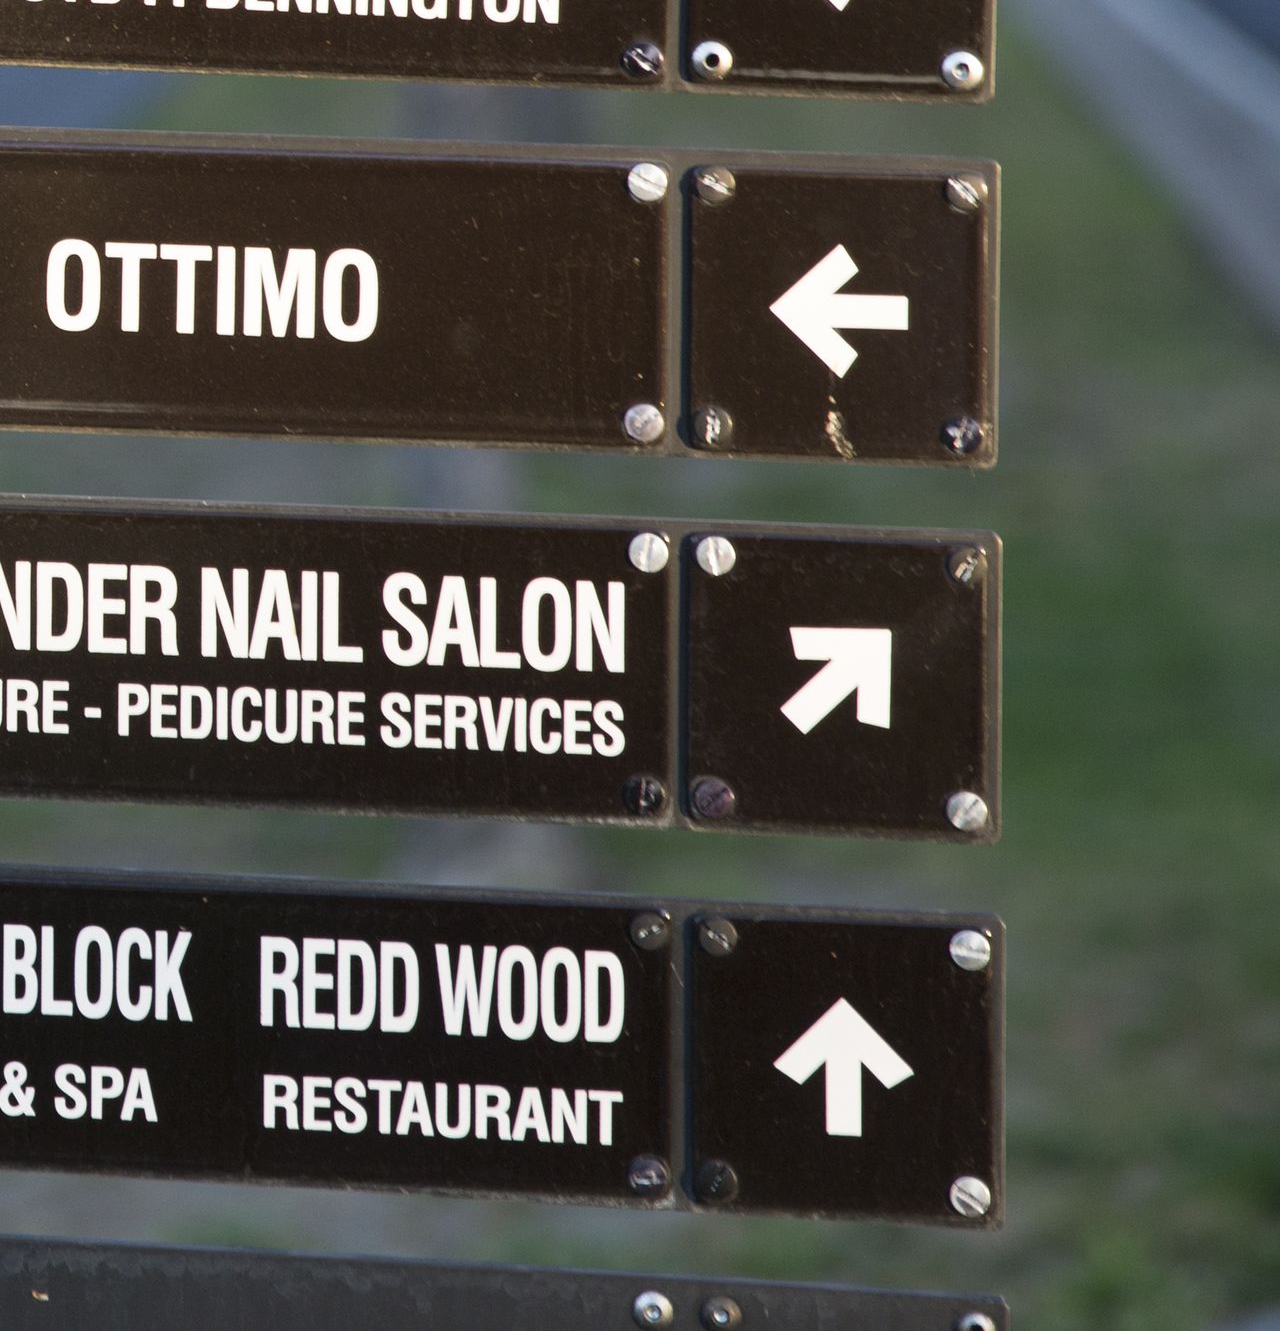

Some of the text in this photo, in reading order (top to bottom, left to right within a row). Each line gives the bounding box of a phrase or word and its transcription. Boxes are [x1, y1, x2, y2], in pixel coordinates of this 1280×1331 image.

[45, 238, 379, 343] OTTIMO
[200, 566, 364, 663] NAIL
[381, 571, 626, 674] SALON
[83, 706, 102, 719] -
[117, 682, 366, 746] PEDICURE
[380, 691, 626, 758] SERVICES
[2, 923, 193, 1022] BLOCK
[260, 935, 625, 1043] REDD WOOD
[54, 1063, 158, 1123] SPA
[263, 1074, 624, 1146] RESTAURANT
